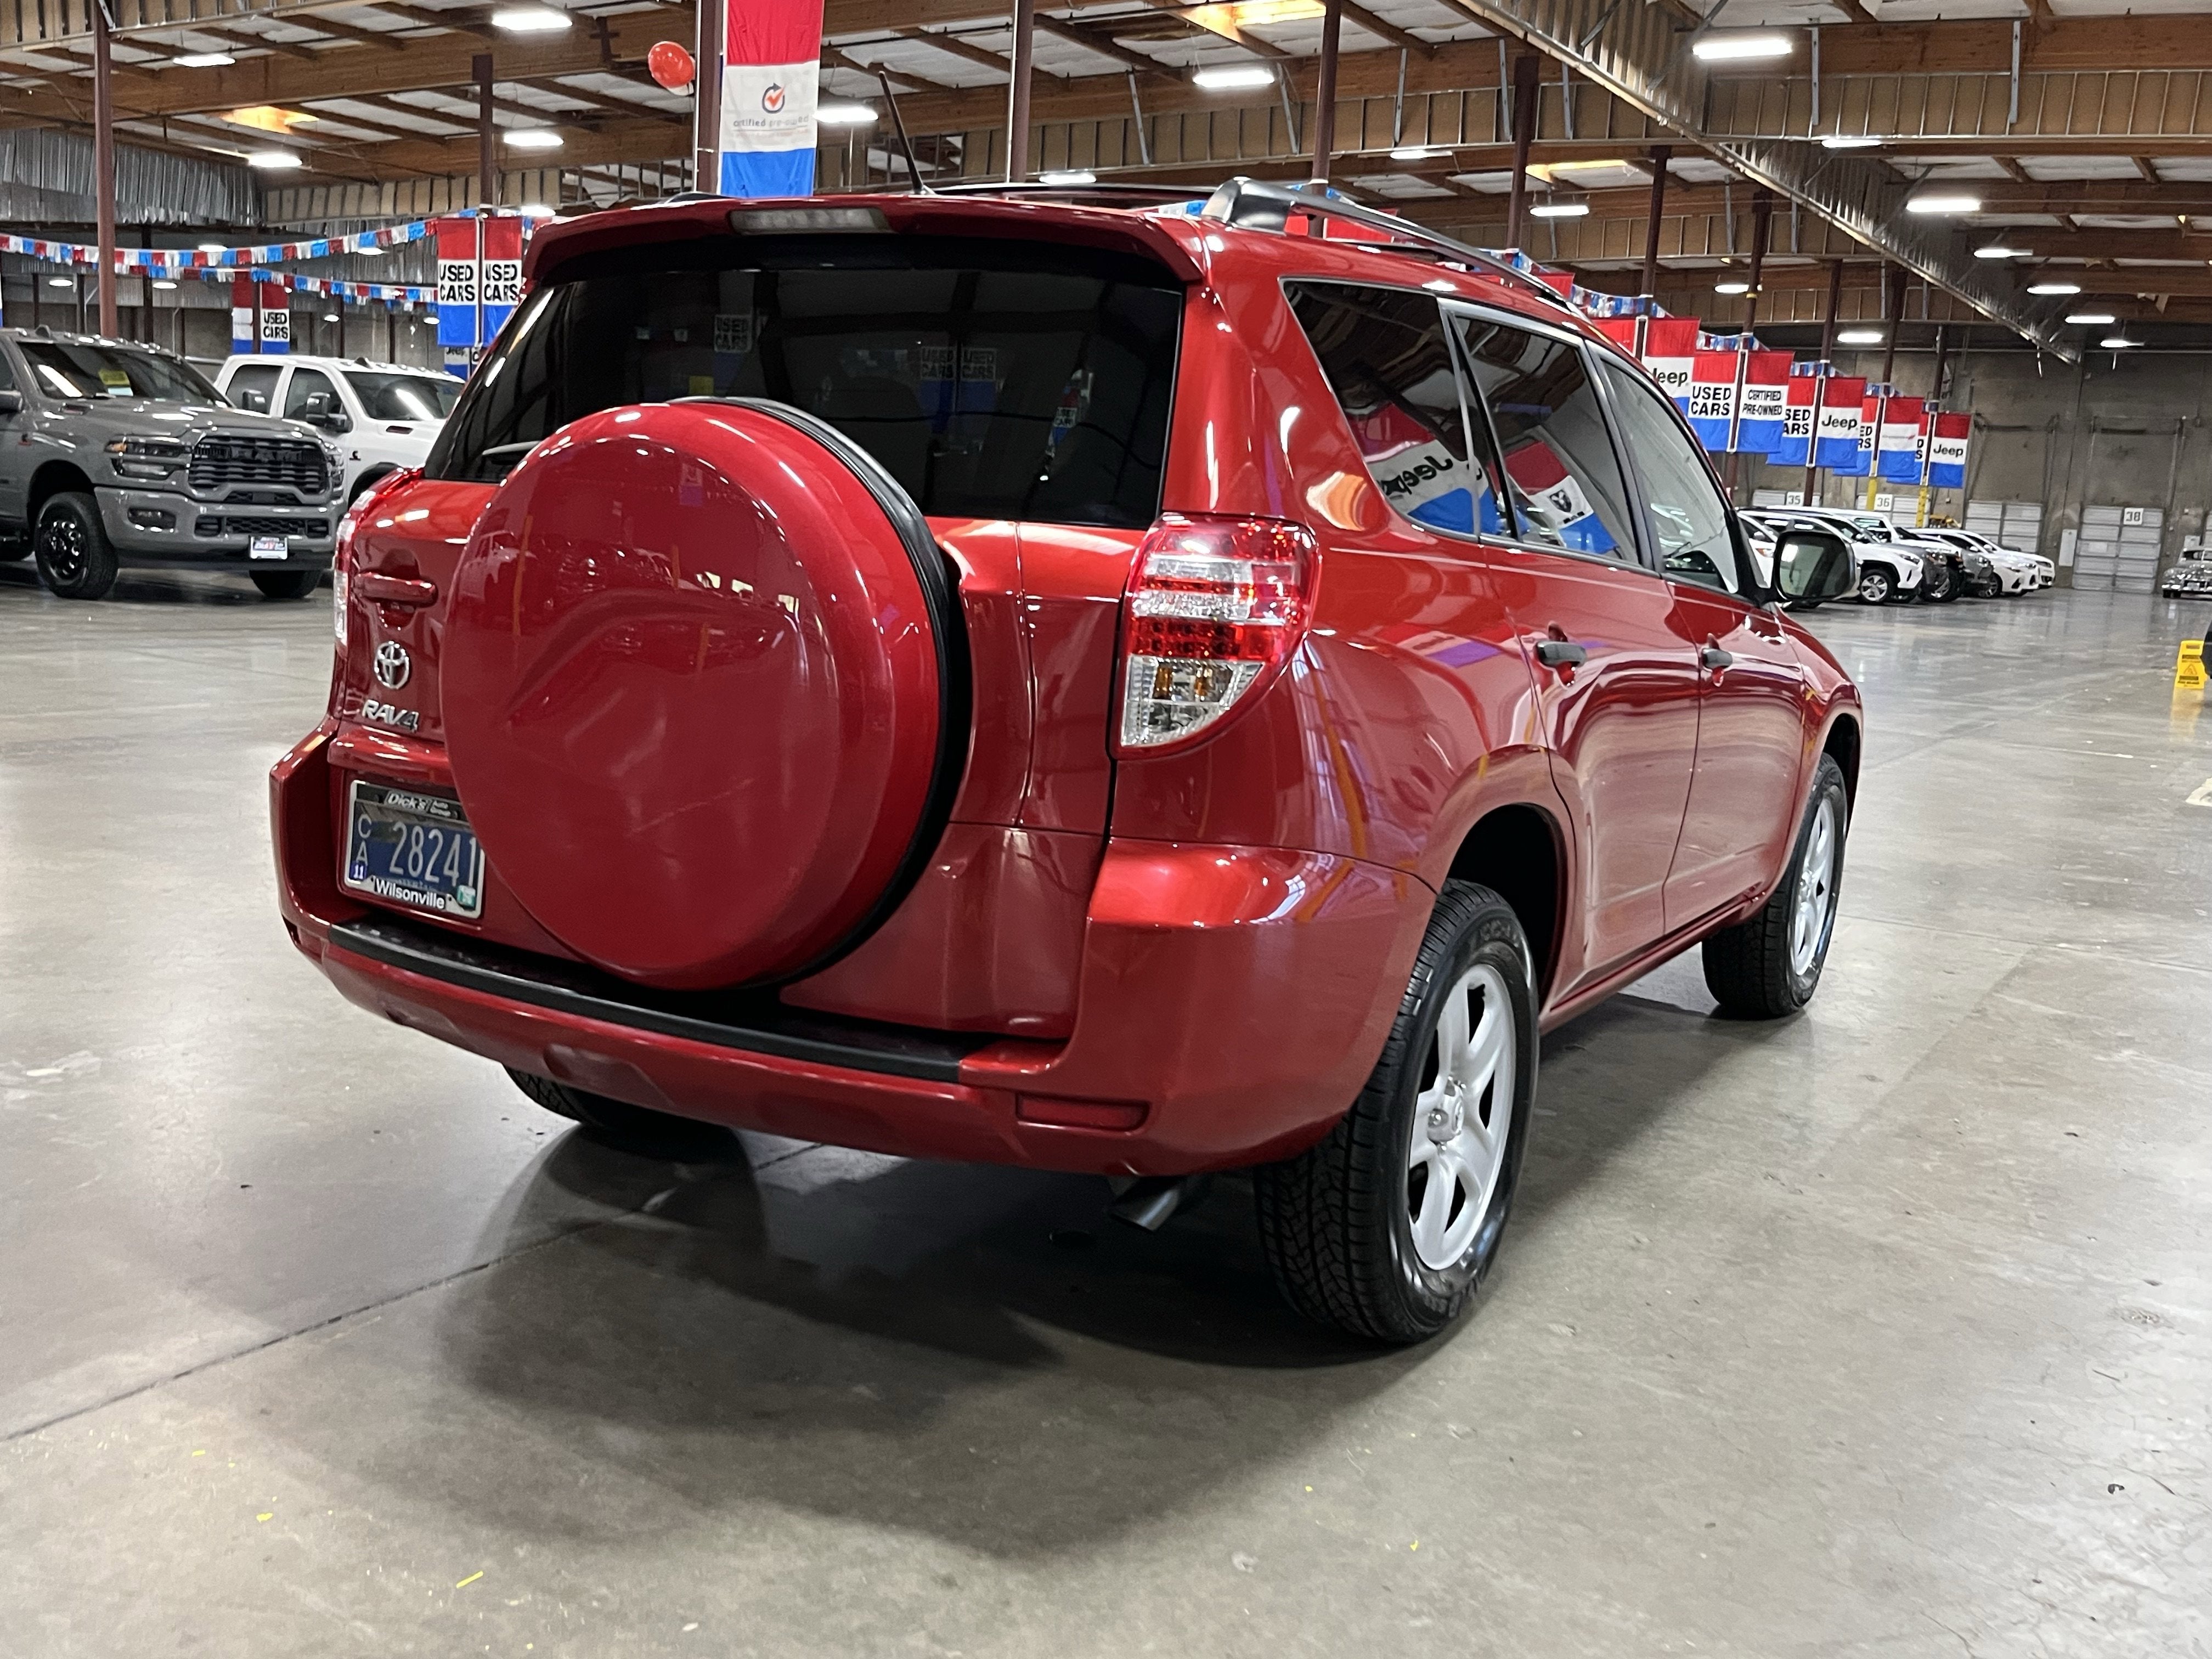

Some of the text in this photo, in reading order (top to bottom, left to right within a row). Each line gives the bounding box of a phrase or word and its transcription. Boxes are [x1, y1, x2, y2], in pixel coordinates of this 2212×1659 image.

[440, 264, 473, 281] USED
[486, 264, 517, 281] USED
[440, 284, 475, 301] CARS
[484, 284, 518, 301] CARS
[264, 312, 287, 324] USED
[1692, 386, 1731, 400] USED
[1748, 390, 1782, 401] CERTIFIED
[1691, 401, 1730, 416] CARS
[1742, 403, 1782, 415] PRE-OWNED
[1785, 409, 1810, 421] SED
[1784, 423, 1809, 435] ARS
[1821, 415, 1858, 430] Jeep
[1933, 444, 1963, 458] Jeep
[1788, 495, 1801, 505] 35
[1877, 498, 1890, 507] 36
[362, 699, 419, 733] RAV4
[389, 821, 477, 887] 28241
[375, 879, 445, 910] Wilsonville
